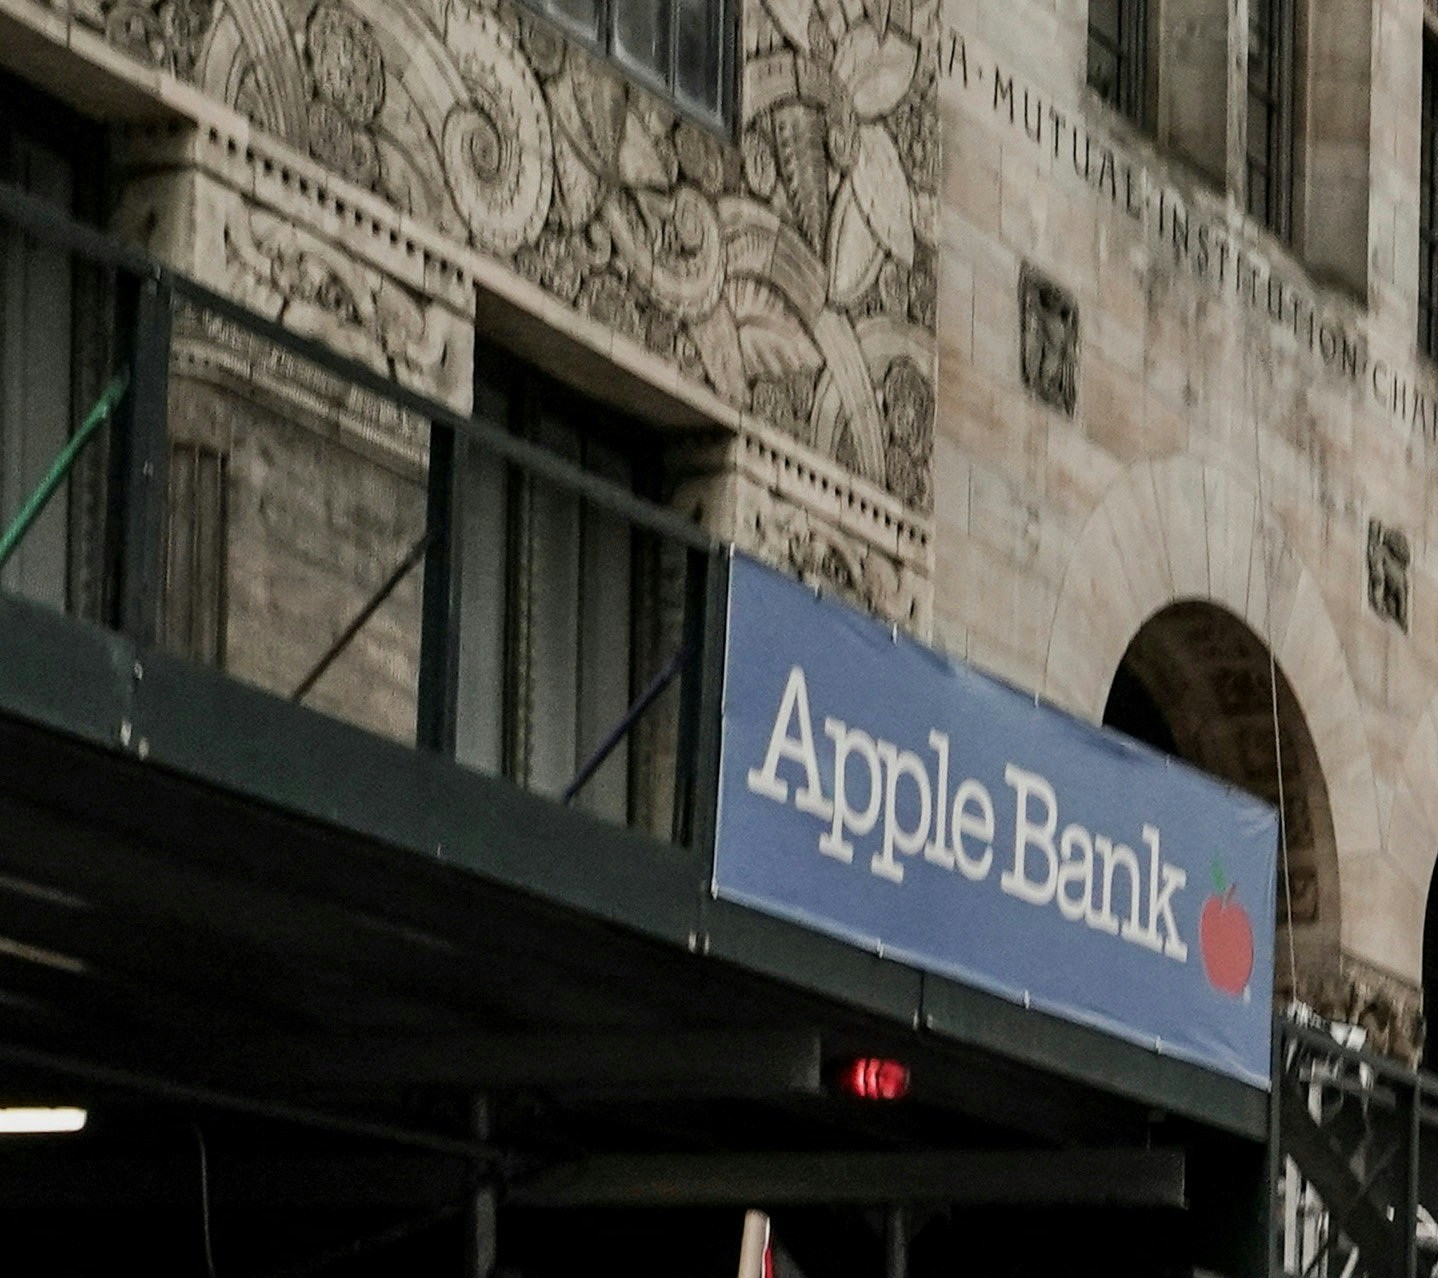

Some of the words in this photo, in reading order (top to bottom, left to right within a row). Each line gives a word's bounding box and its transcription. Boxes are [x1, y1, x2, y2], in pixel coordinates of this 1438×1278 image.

[992, 62, 1141, 221] MUTUAL
[746, 664, 996, 885] Apple
[999, 761, 1190, 964] Bank
